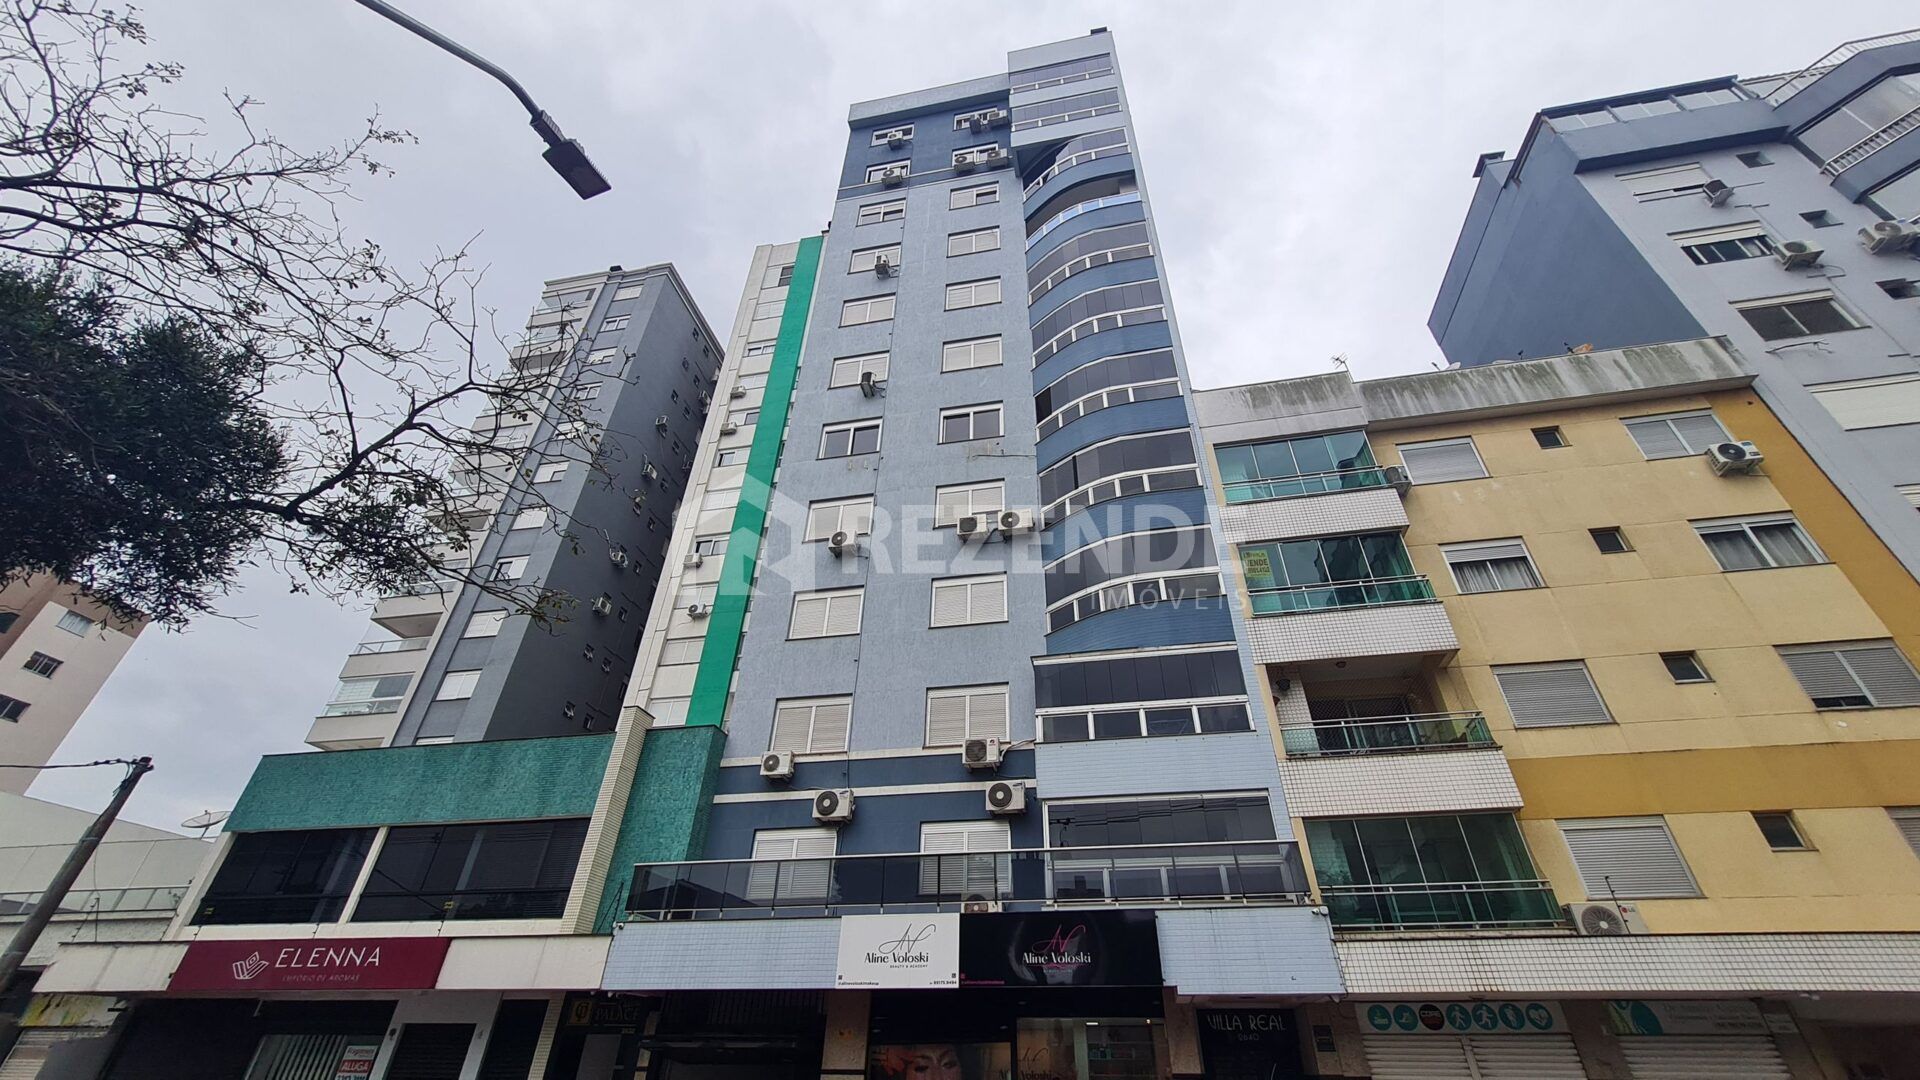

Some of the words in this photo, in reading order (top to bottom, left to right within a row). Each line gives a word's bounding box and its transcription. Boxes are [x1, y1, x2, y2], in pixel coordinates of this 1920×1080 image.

[274, 946, 381, 968] ELENNA
[864, 952, 889, 964] Aline
[892, 952, 929, 964] Voloski
[1022, 952, 1048, 964] Aline
[1051, 951, 1092, 964] Voloski
[1206, 1014, 1243, 1031] VILLA
[1248, 1014, 1288, 1031] REAL
[340, 1060, 371, 1072] ALUGA
